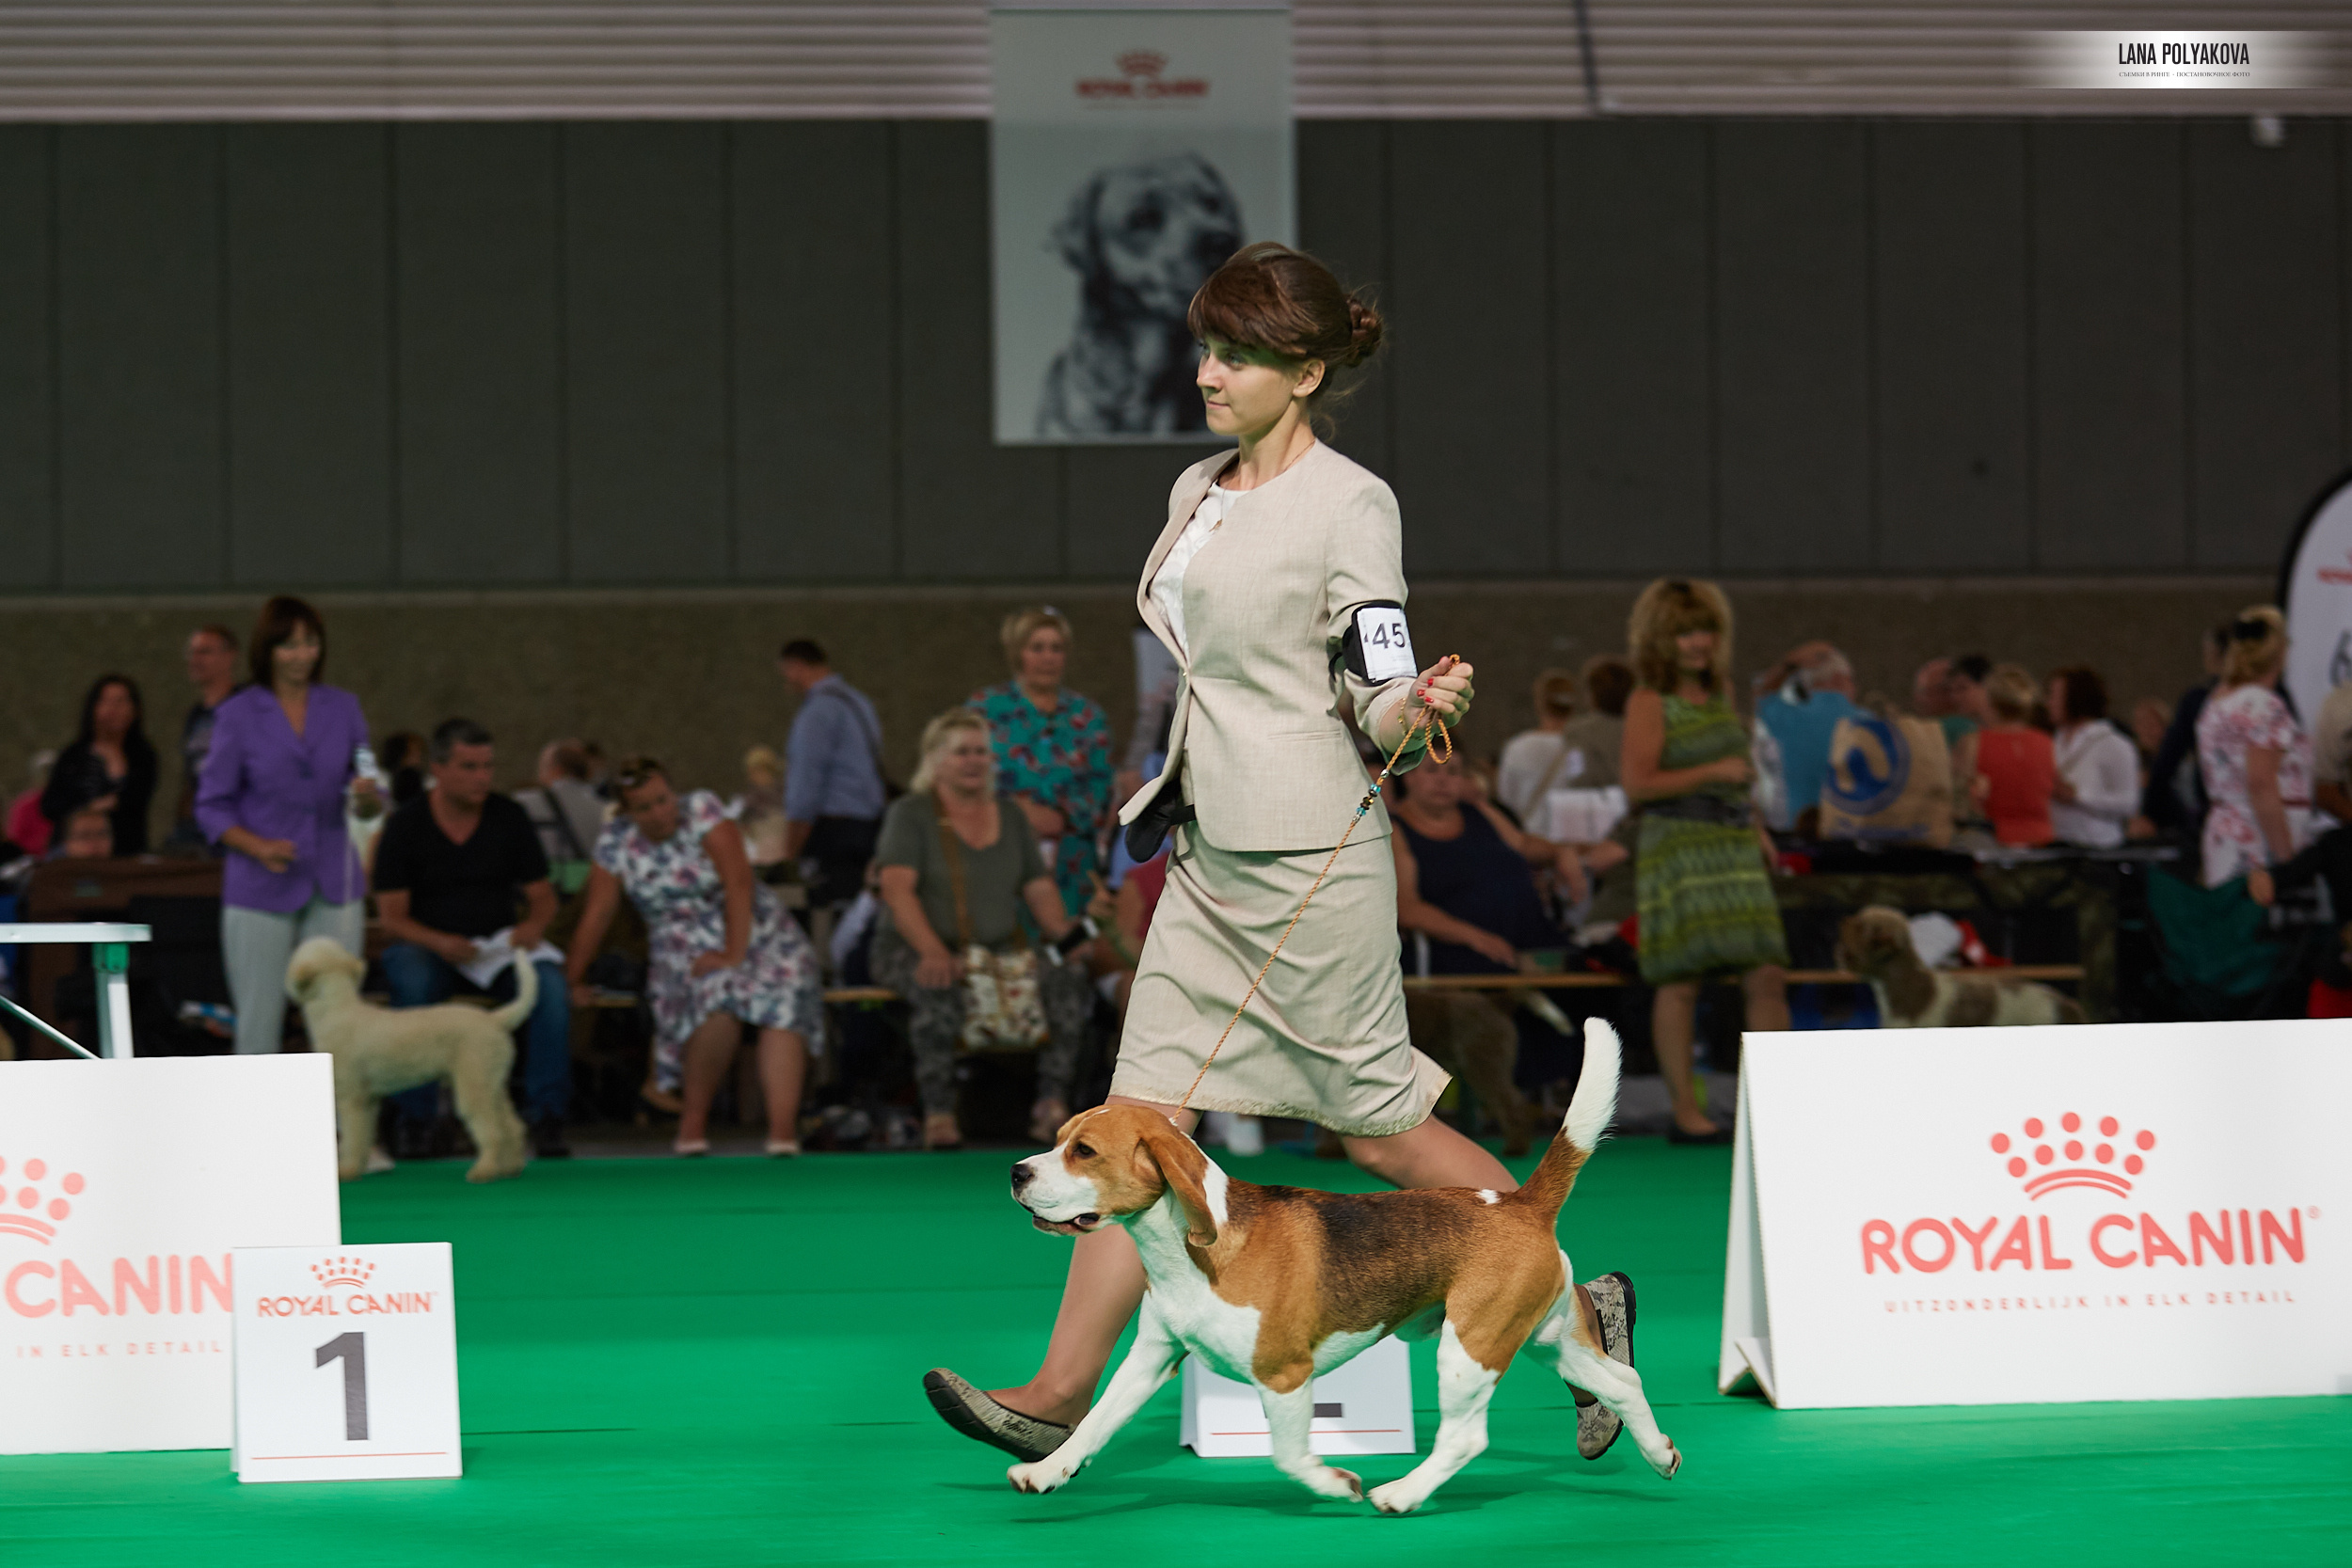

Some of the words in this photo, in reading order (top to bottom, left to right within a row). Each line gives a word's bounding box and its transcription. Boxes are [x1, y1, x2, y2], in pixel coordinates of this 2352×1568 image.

[1859, 1214, 2074, 1275] ROYAL
[2088, 1207, 2306, 1270] CANIN
[3, 1253, 232, 1319] CANIN
[257, 1294, 339, 1317] ROYAL
[345, 1291, 432, 1315] CANIN
[1884, 1295, 2088, 1313] UITZONDERLIJK
[2104, 1294, 2129, 1307] IN
[2145, 1292, 2190, 1307] ELK
[2205, 1290, 2296, 1305] DETAIL
[16, 1345, 42, 1357] IN
[59, 1343, 108, 1357] ELK
[125, 1340, 222, 1355] DETAIL
[314, 1331, 369, 1441] 1
